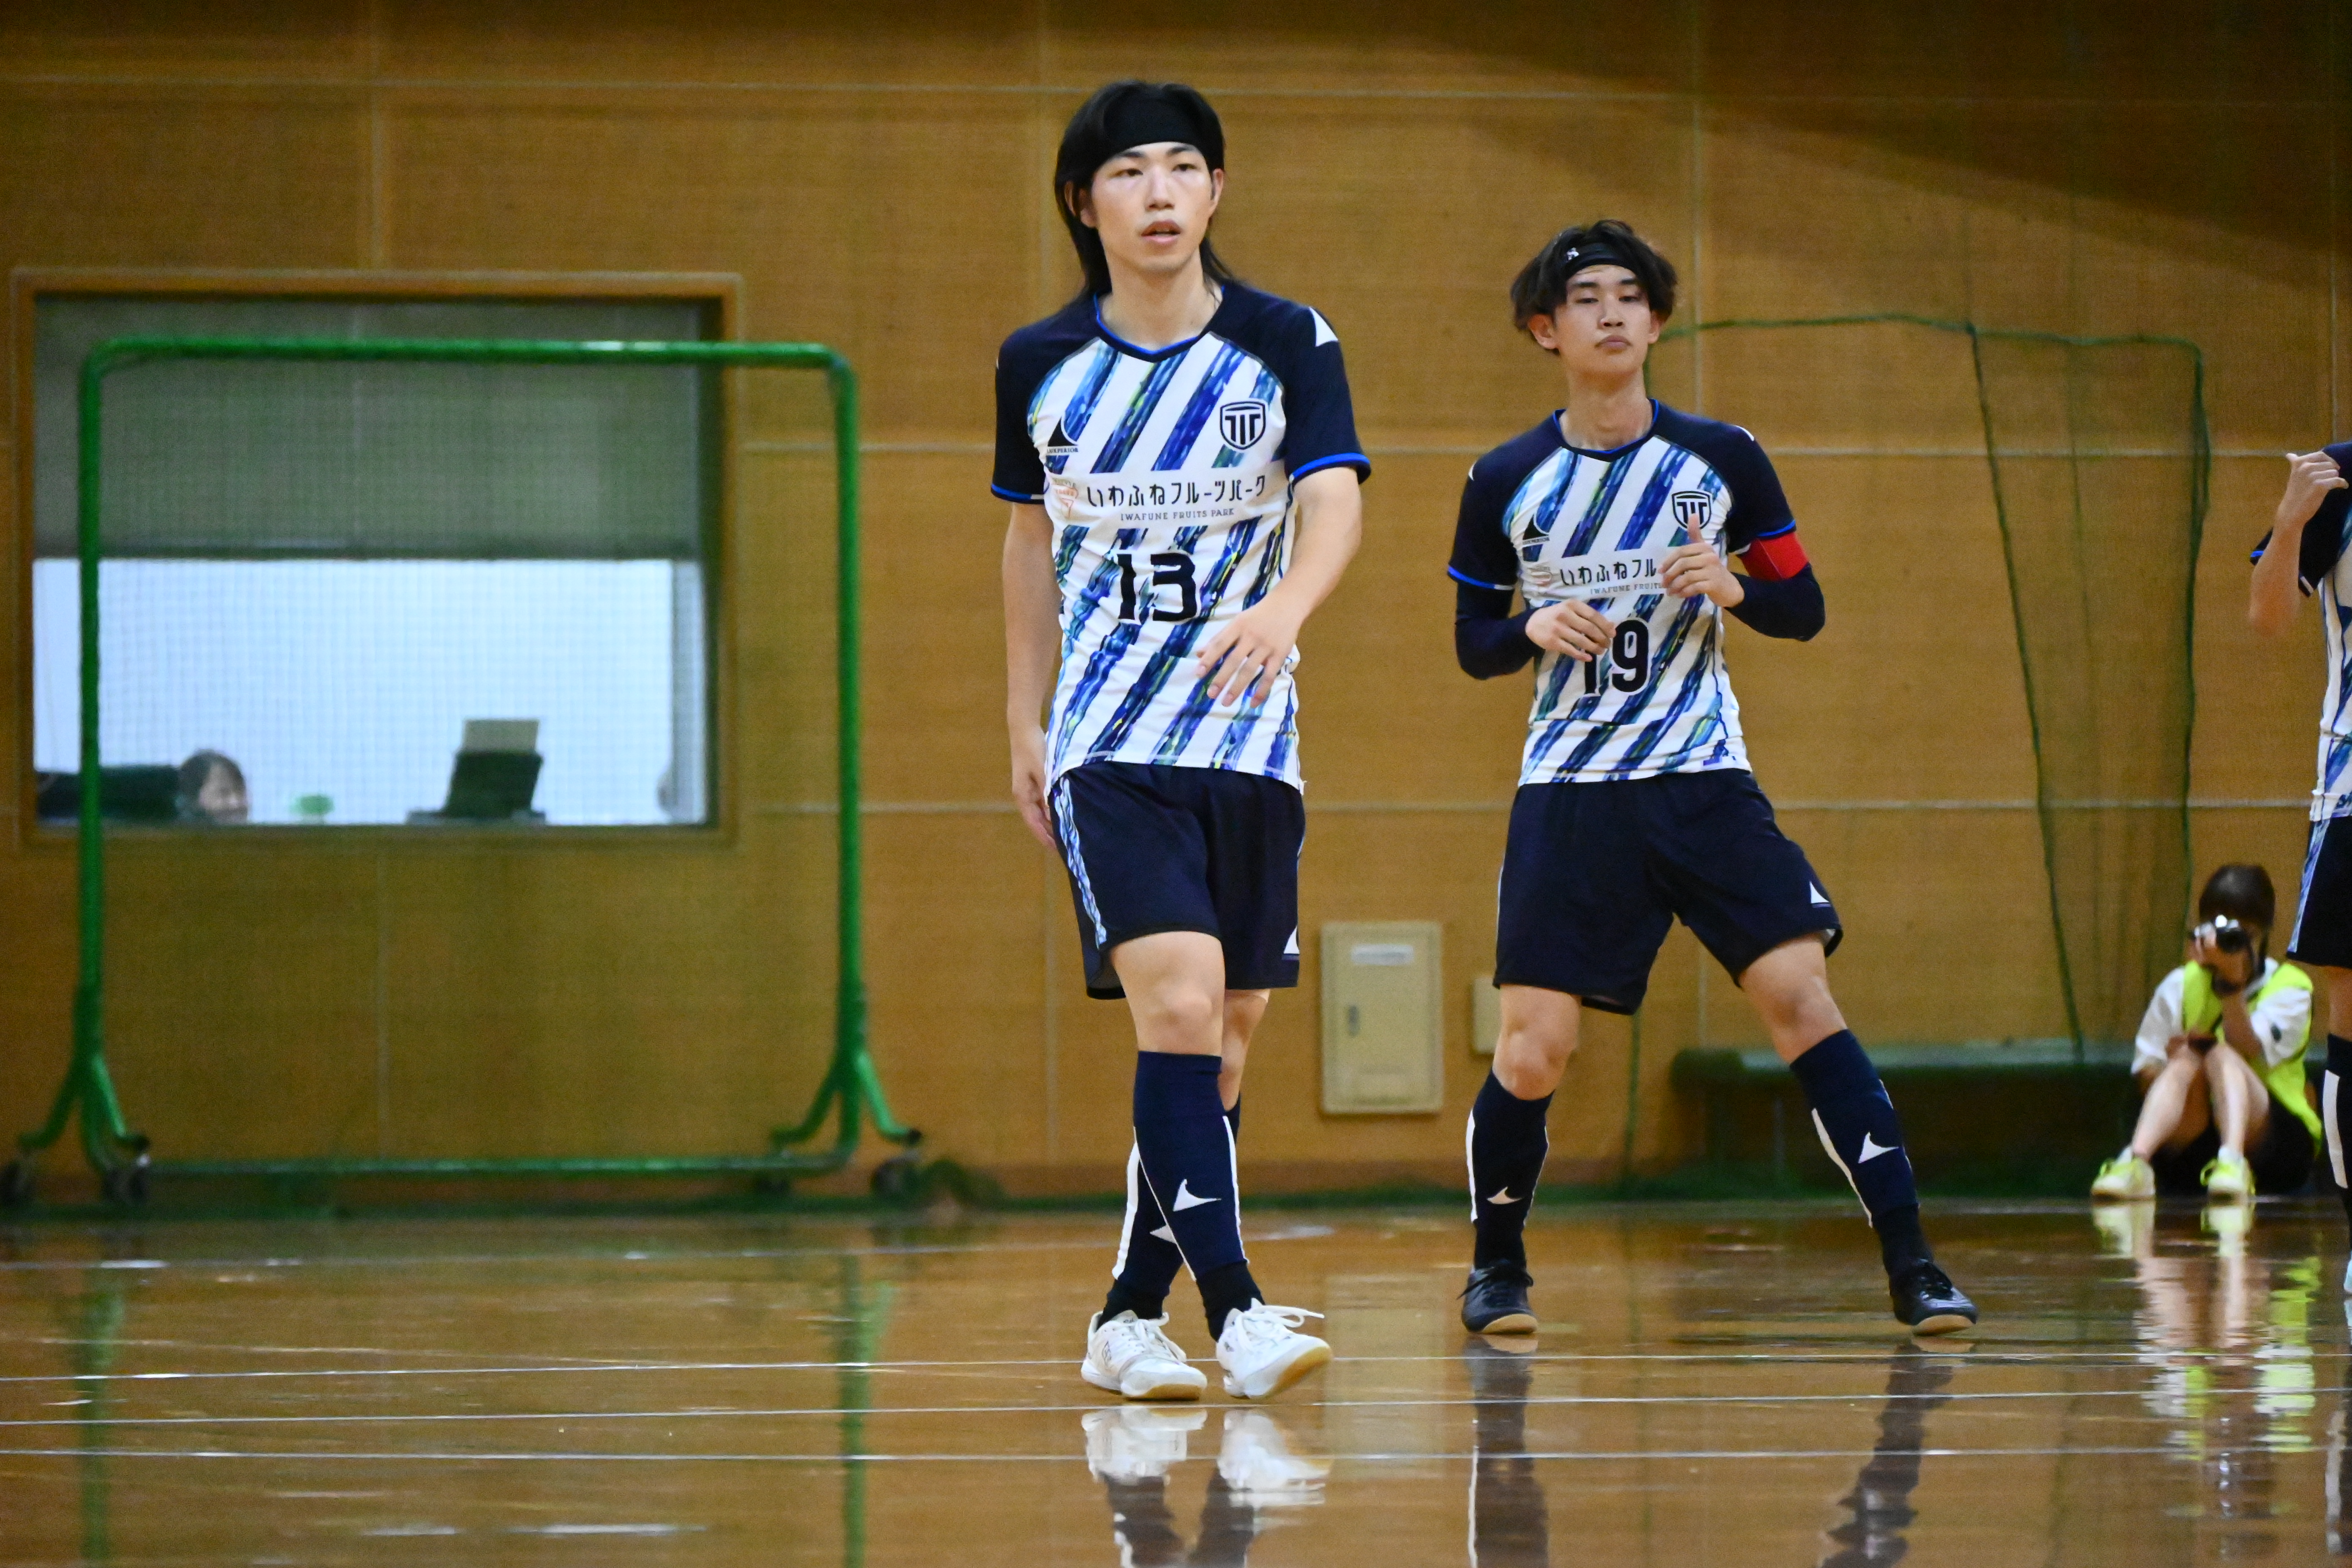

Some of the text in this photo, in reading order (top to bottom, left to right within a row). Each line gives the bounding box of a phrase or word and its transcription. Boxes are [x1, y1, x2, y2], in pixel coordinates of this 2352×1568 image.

[1087, 475, 1265, 507] いわふねフルーツパーク
[1121, 508, 1234, 520] IWAFUNE FRUITS PARK
[1117, 553, 1197, 621] 13
[1590, 585, 1631, 594] IWAFUNE
